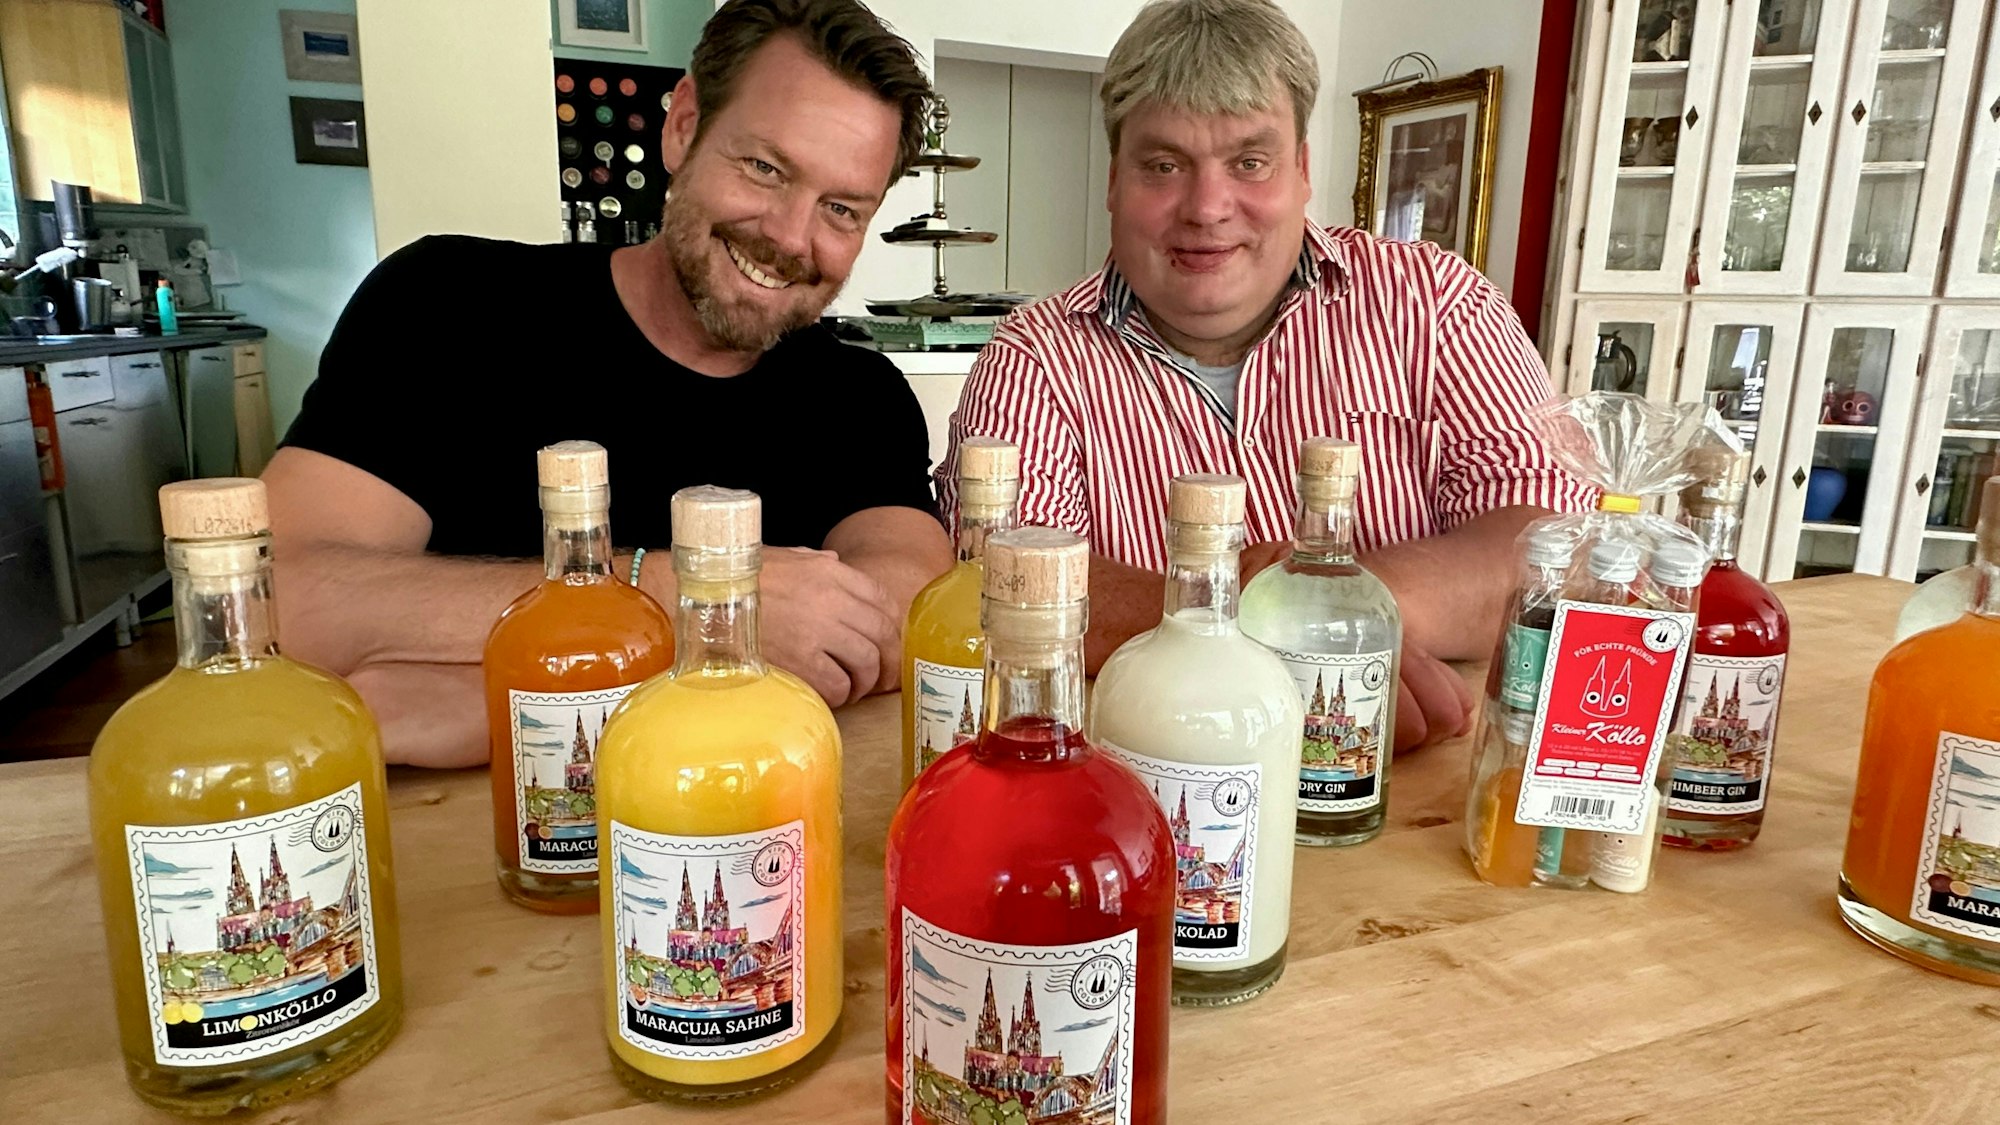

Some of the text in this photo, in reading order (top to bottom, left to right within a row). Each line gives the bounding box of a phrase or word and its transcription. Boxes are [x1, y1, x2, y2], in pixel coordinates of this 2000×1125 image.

[1552, 721, 1647, 746] Kleiner Köllo
[1298, 781, 1346, 793] DRY GIN
[1727, 786, 1747, 796] GIN
[1077, 960, 1113, 1005] VIVA COLONIA
[635, 1008, 782, 1035] MARACUJA SAHNE
